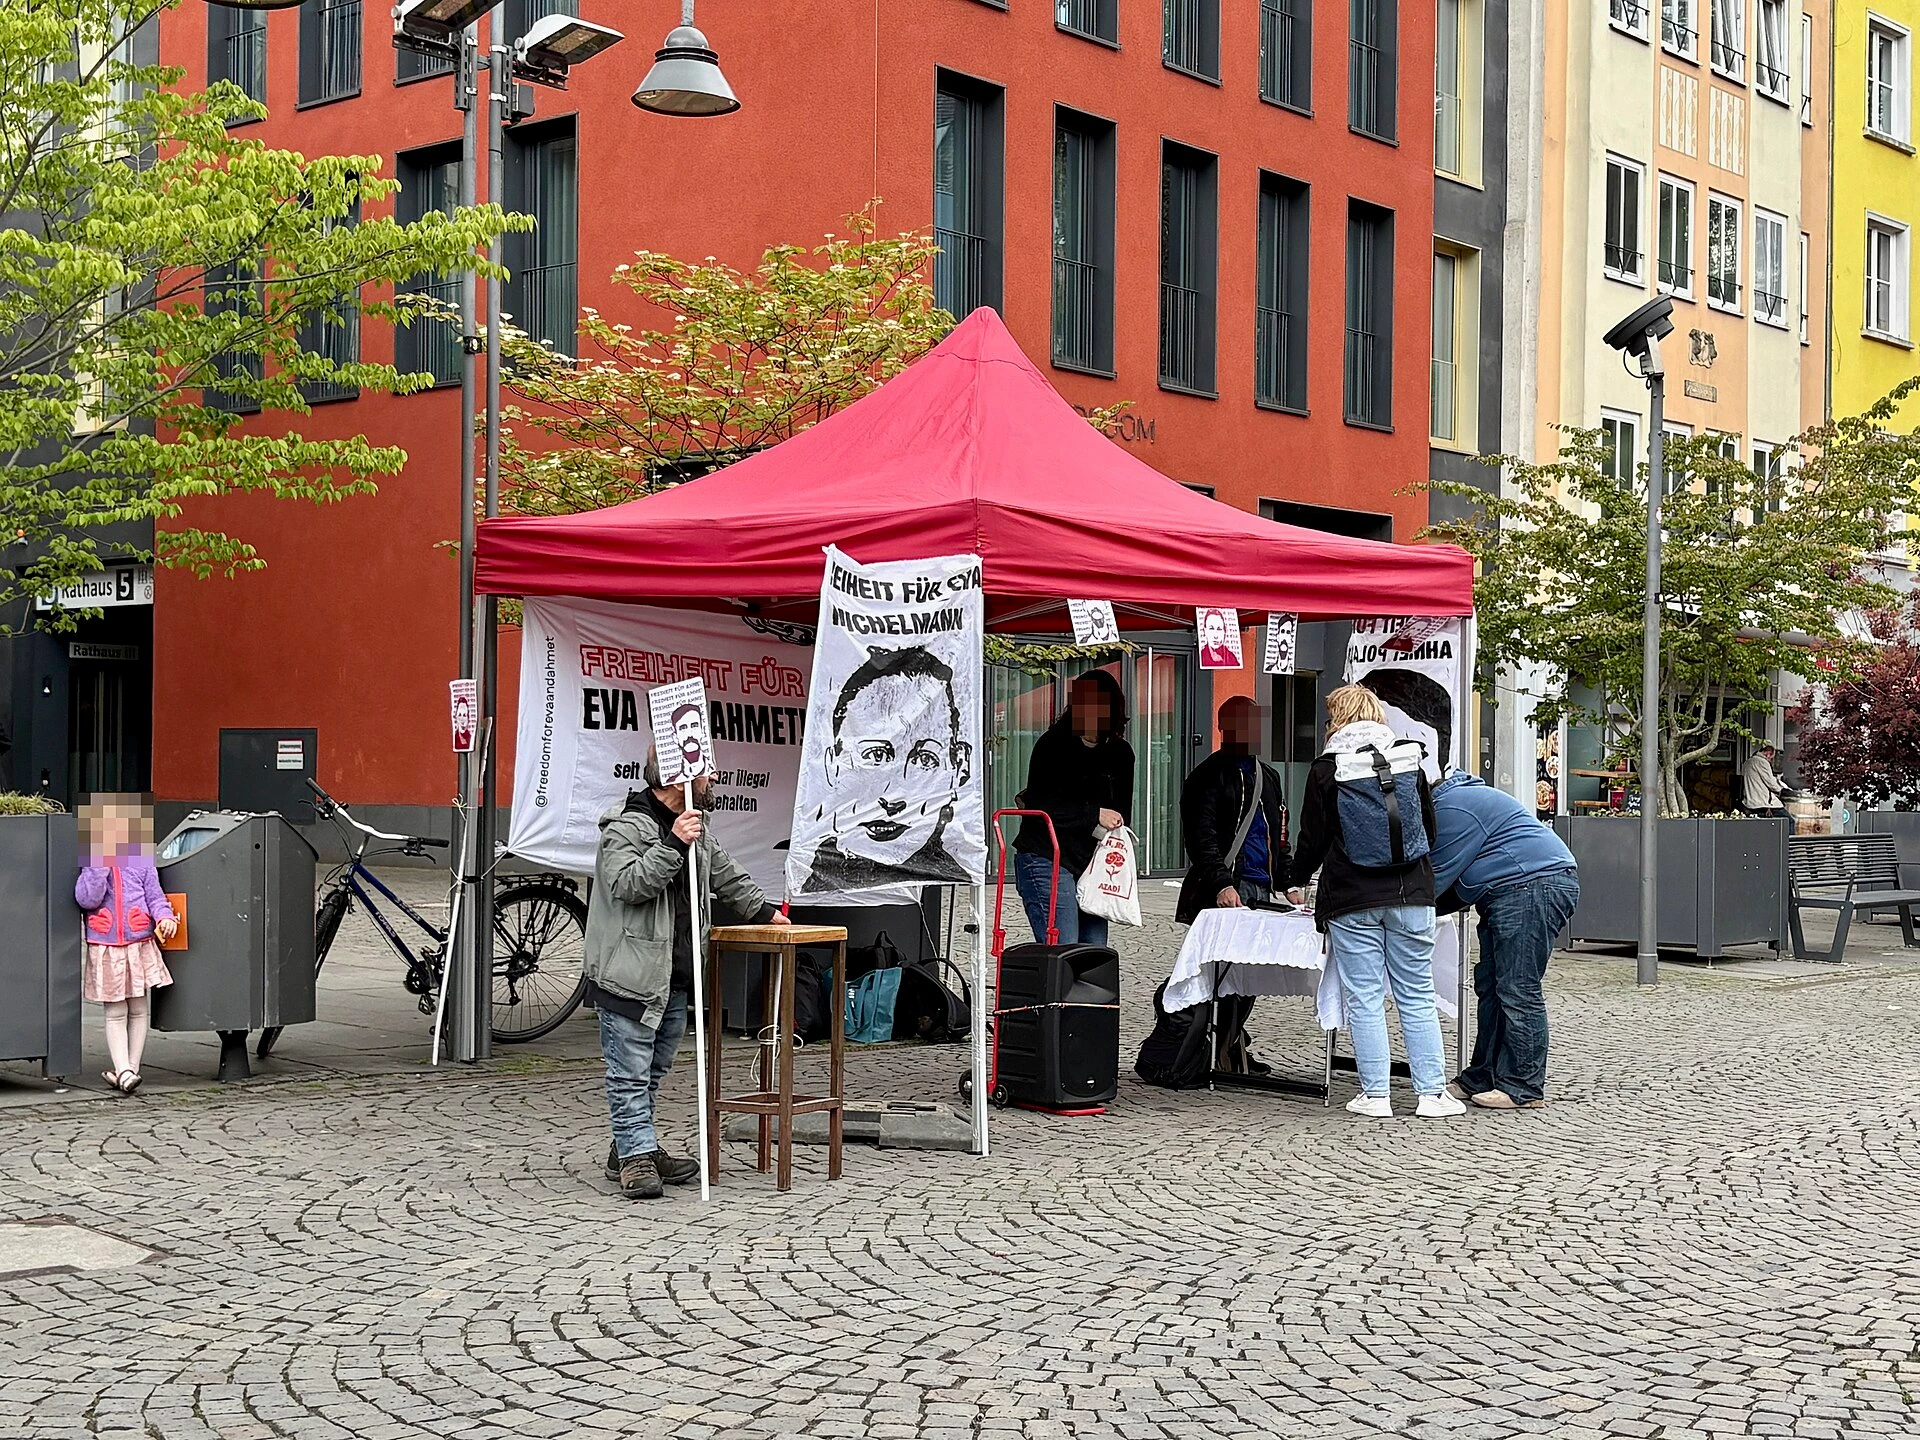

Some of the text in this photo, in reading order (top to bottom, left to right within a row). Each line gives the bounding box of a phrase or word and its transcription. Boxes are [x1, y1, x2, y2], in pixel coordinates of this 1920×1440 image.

[902, 576, 942, 603] FÜR
[580, 644, 805, 697] FREIHEIT FÜR
[536, 636, 555, 807] @freedomforevaandahmet
[583, 688, 638, 731] EVA
[613, 761, 640, 780] seit
[736, 769, 770, 788] illegal
